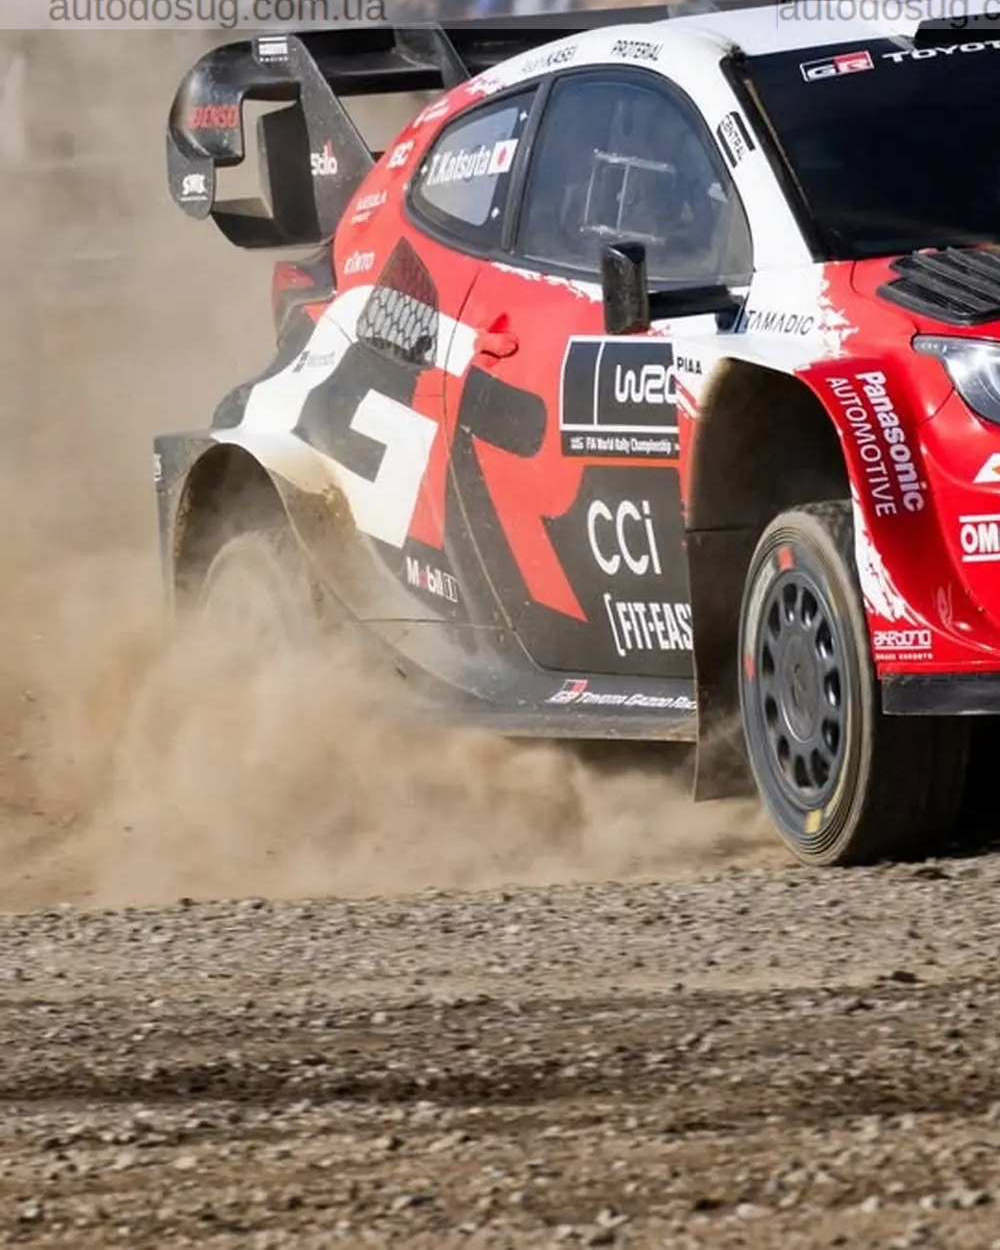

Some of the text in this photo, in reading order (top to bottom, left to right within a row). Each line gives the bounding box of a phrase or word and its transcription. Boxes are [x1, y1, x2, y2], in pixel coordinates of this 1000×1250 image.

[676, 356, 703, 375] PIAA
[825, 377, 897, 518] AUTOMOTIVE
[856, 370, 925, 513] Panasonic
